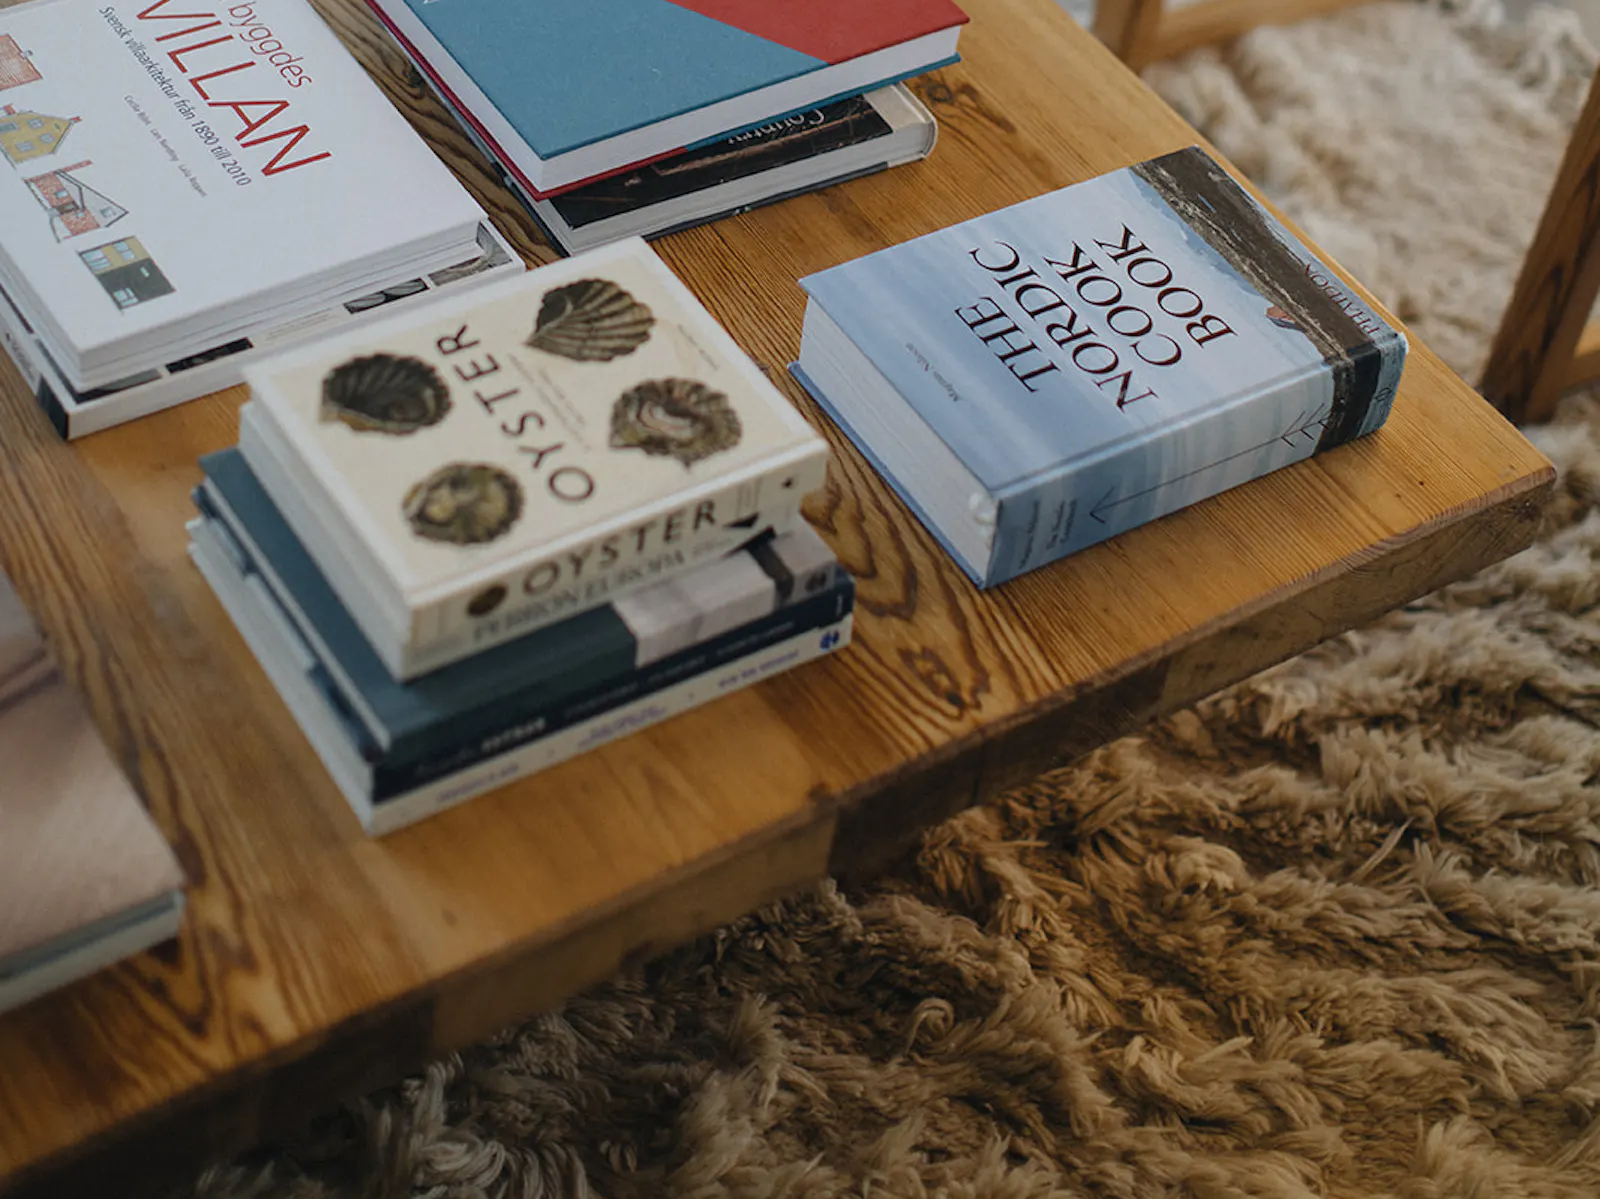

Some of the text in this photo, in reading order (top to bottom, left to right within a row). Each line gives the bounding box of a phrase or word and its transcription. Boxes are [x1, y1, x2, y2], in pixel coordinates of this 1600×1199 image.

[99, 6, 133, 40] Svensk
[228, 0, 313, 88] byggdes
[124, 37, 181, 100] villaarkitektur
[174, 97, 196, 121] från
[191, 120, 220, 146] 1890
[211, 145, 232, 161] till
[221, 159, 252, 187] 2010
[1043, 240, 1183, 367] COOK
[1092, 222, 1239, 349] BOOK
[1304, 263, 1380, 335] PHAIDON
[954, 296, 1062, 393] THE
[968, 240, 1160, 413] NORDIC
[436, 324, 595, 503] OYSTER
[522, 499, 719, 597] OYSTER
